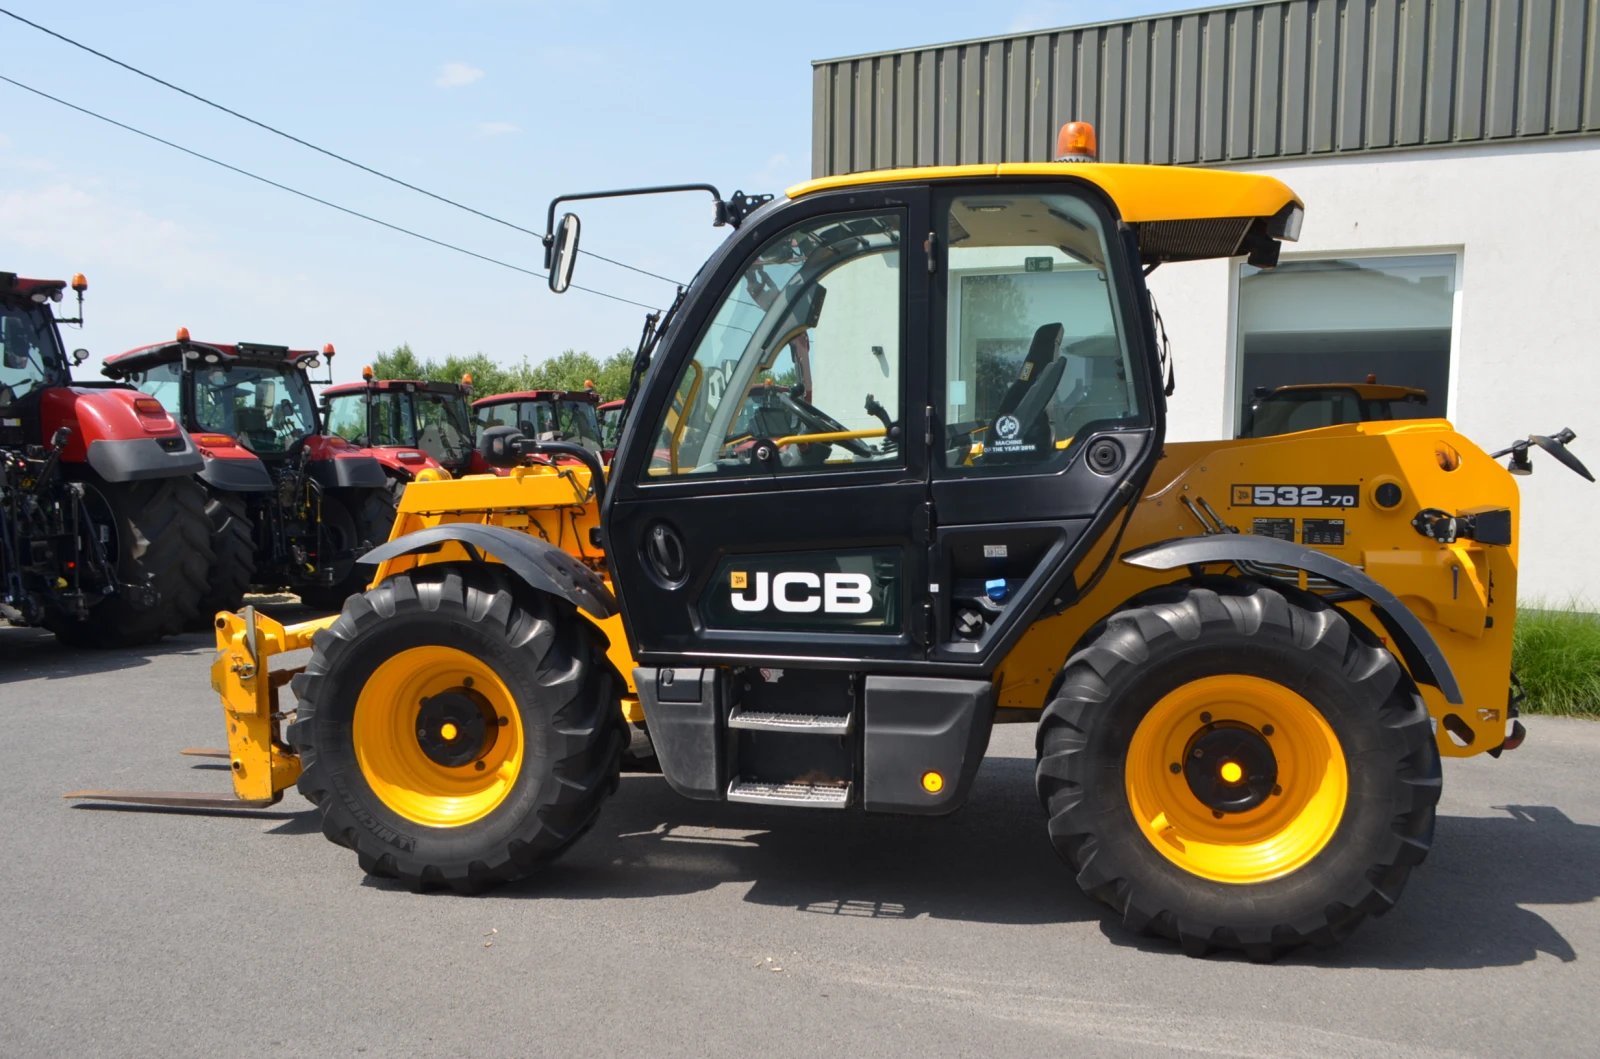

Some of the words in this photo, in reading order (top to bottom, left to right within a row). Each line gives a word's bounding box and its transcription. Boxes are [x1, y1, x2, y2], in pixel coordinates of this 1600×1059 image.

[1254, 486, 1354, 506] 532-70
[731, 572, 873, 613] JCB
[332, 775, 398, 843] MICHELIN
